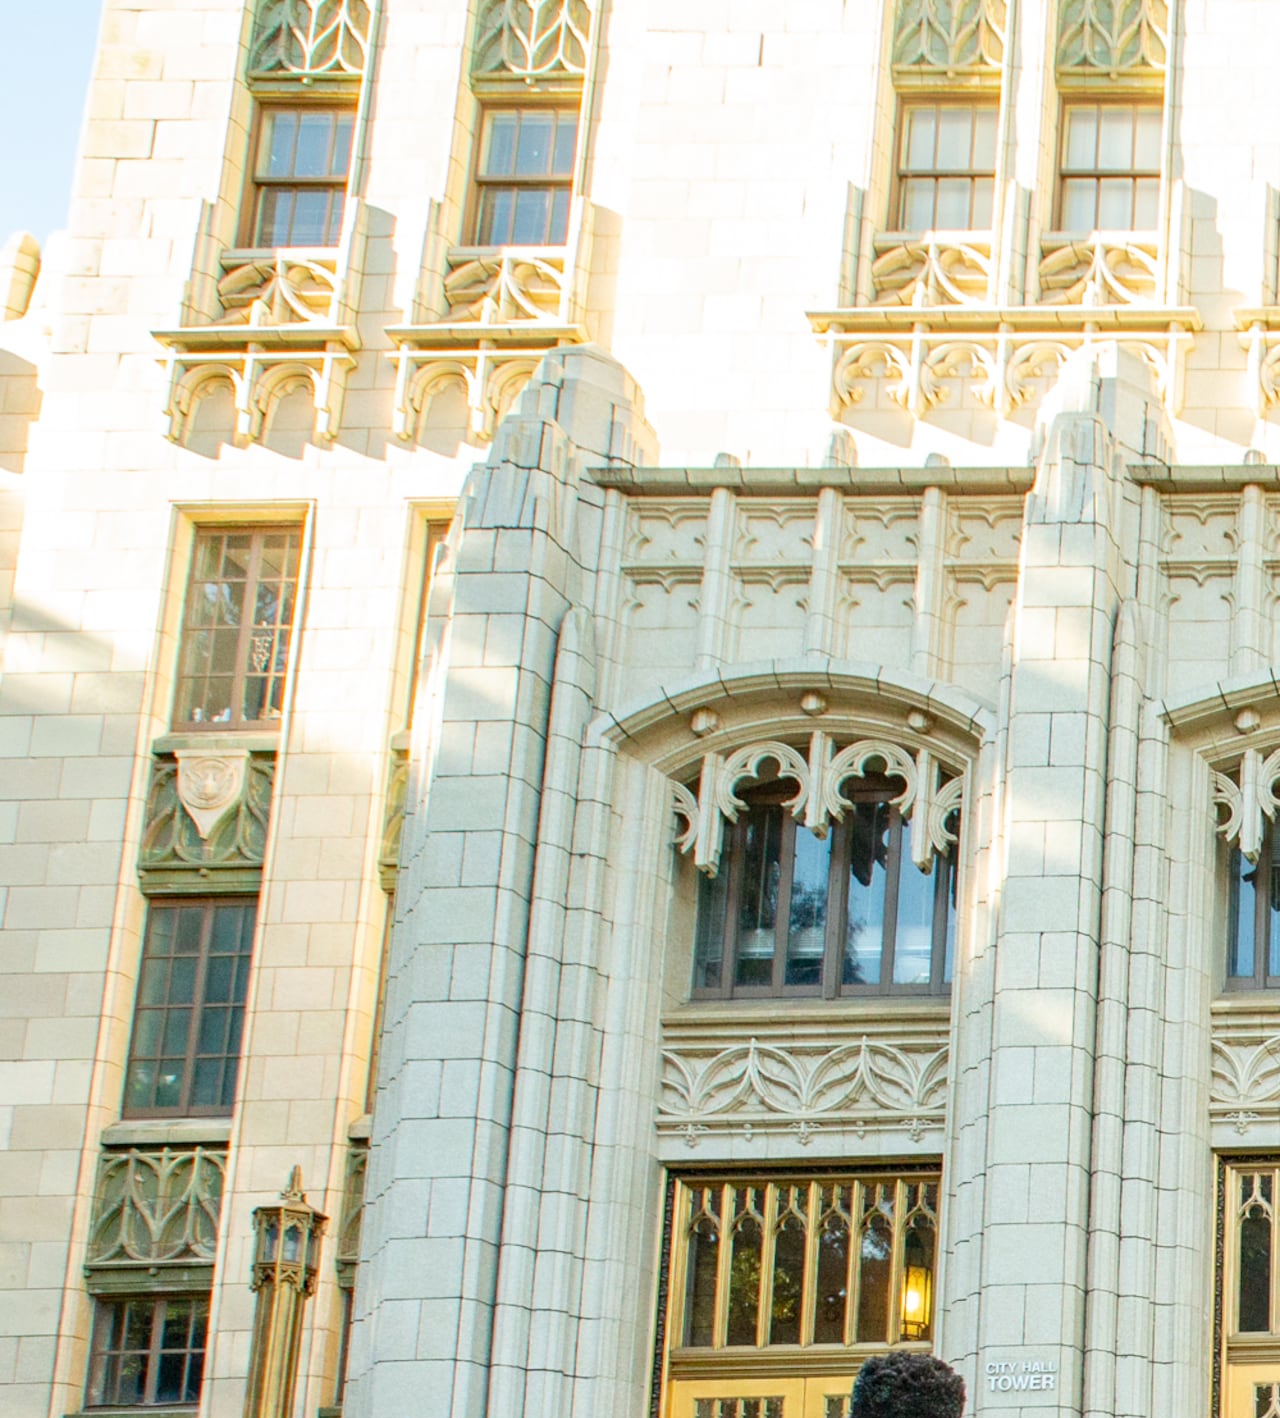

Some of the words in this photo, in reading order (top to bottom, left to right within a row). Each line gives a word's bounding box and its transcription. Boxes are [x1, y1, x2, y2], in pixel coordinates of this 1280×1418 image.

[986, 1362, 1017, 1375] CITY
[1022, 1361, 1057, 1373] HALL
[988, 1375, 1055, 1392] TOWER
